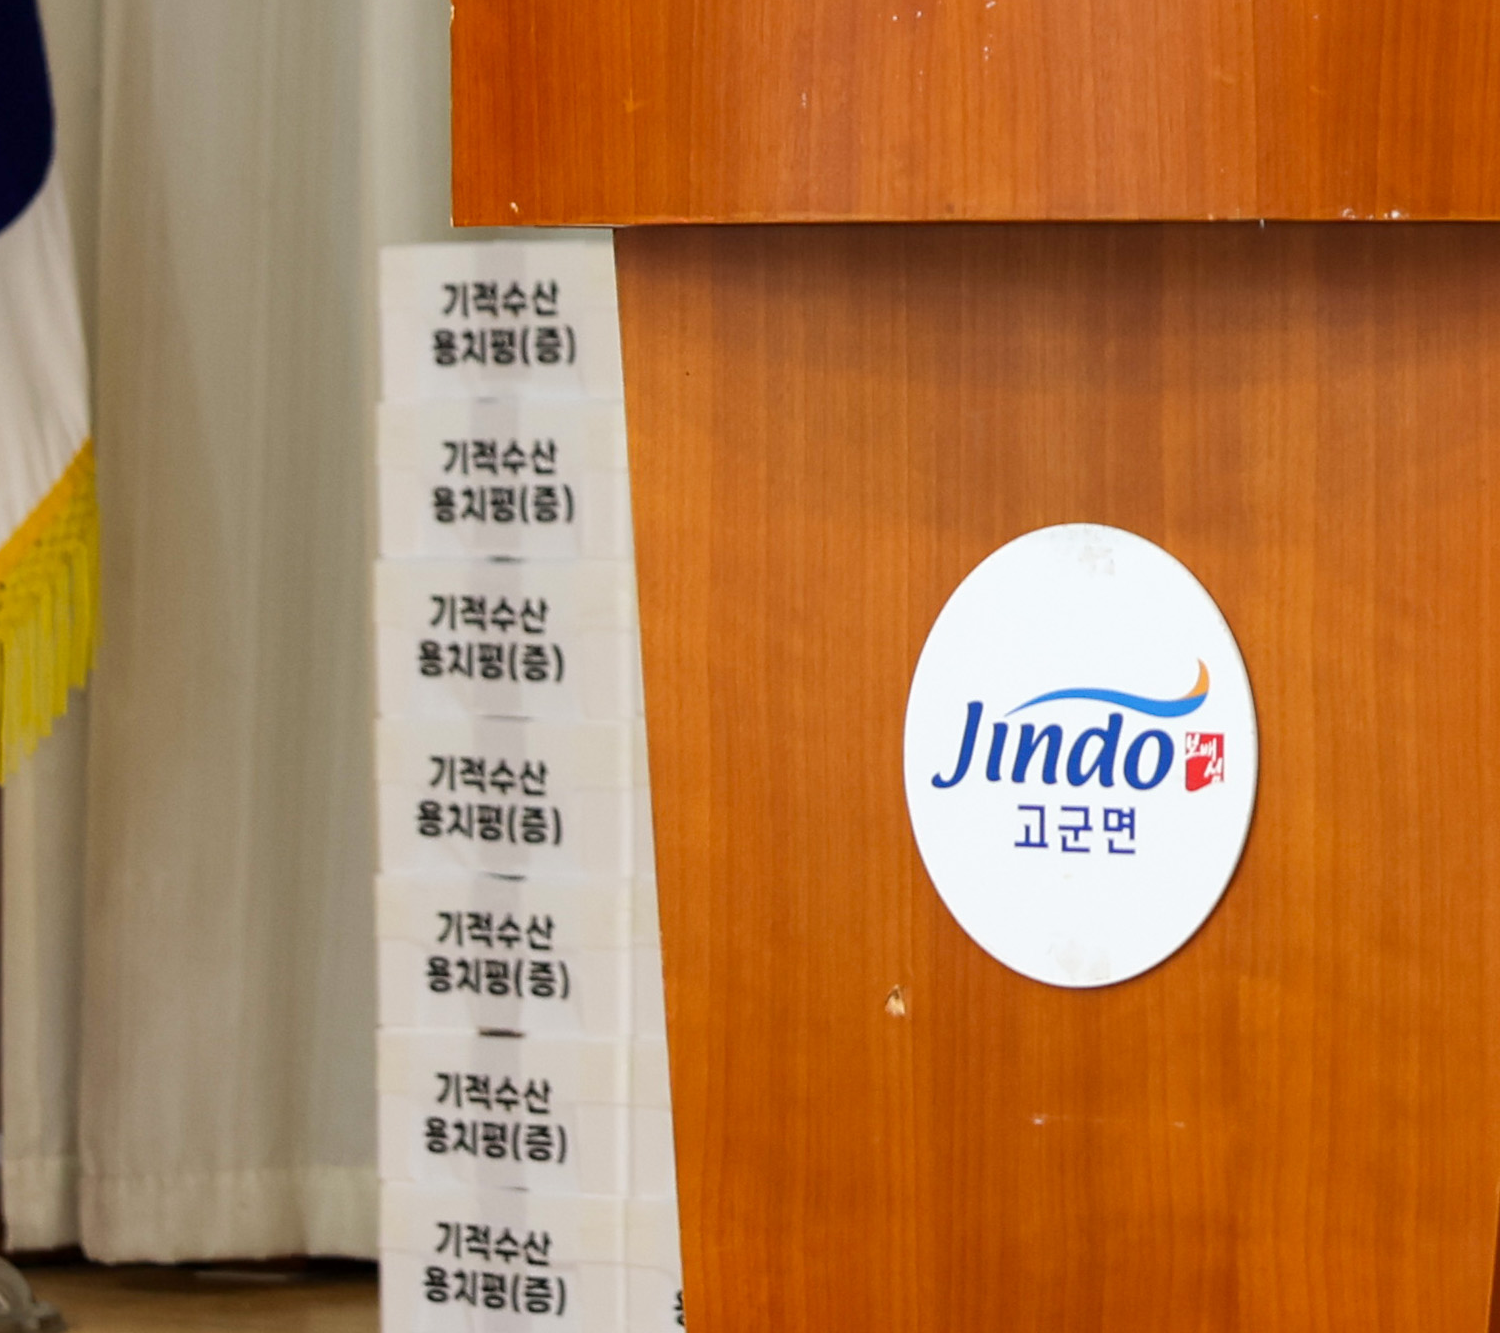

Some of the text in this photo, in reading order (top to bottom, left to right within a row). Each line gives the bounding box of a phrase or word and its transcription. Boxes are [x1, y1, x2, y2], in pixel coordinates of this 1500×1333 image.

[442, 279, 559, 318] 기적수산
[442, 438, 557, 475] 기적수산
[430, 595, 548, 634] 기적수산
[931, 700, 1175, 791] Jindo
[429, 755, 547, 796] 기적수산
[1014, 803, 1136, 855] 고군면
[437, 911, 555, 951] 기적수산
[436, 1072, 552, 1114] 기적수산
[436, 1222, 552, 1267] 기적수산
